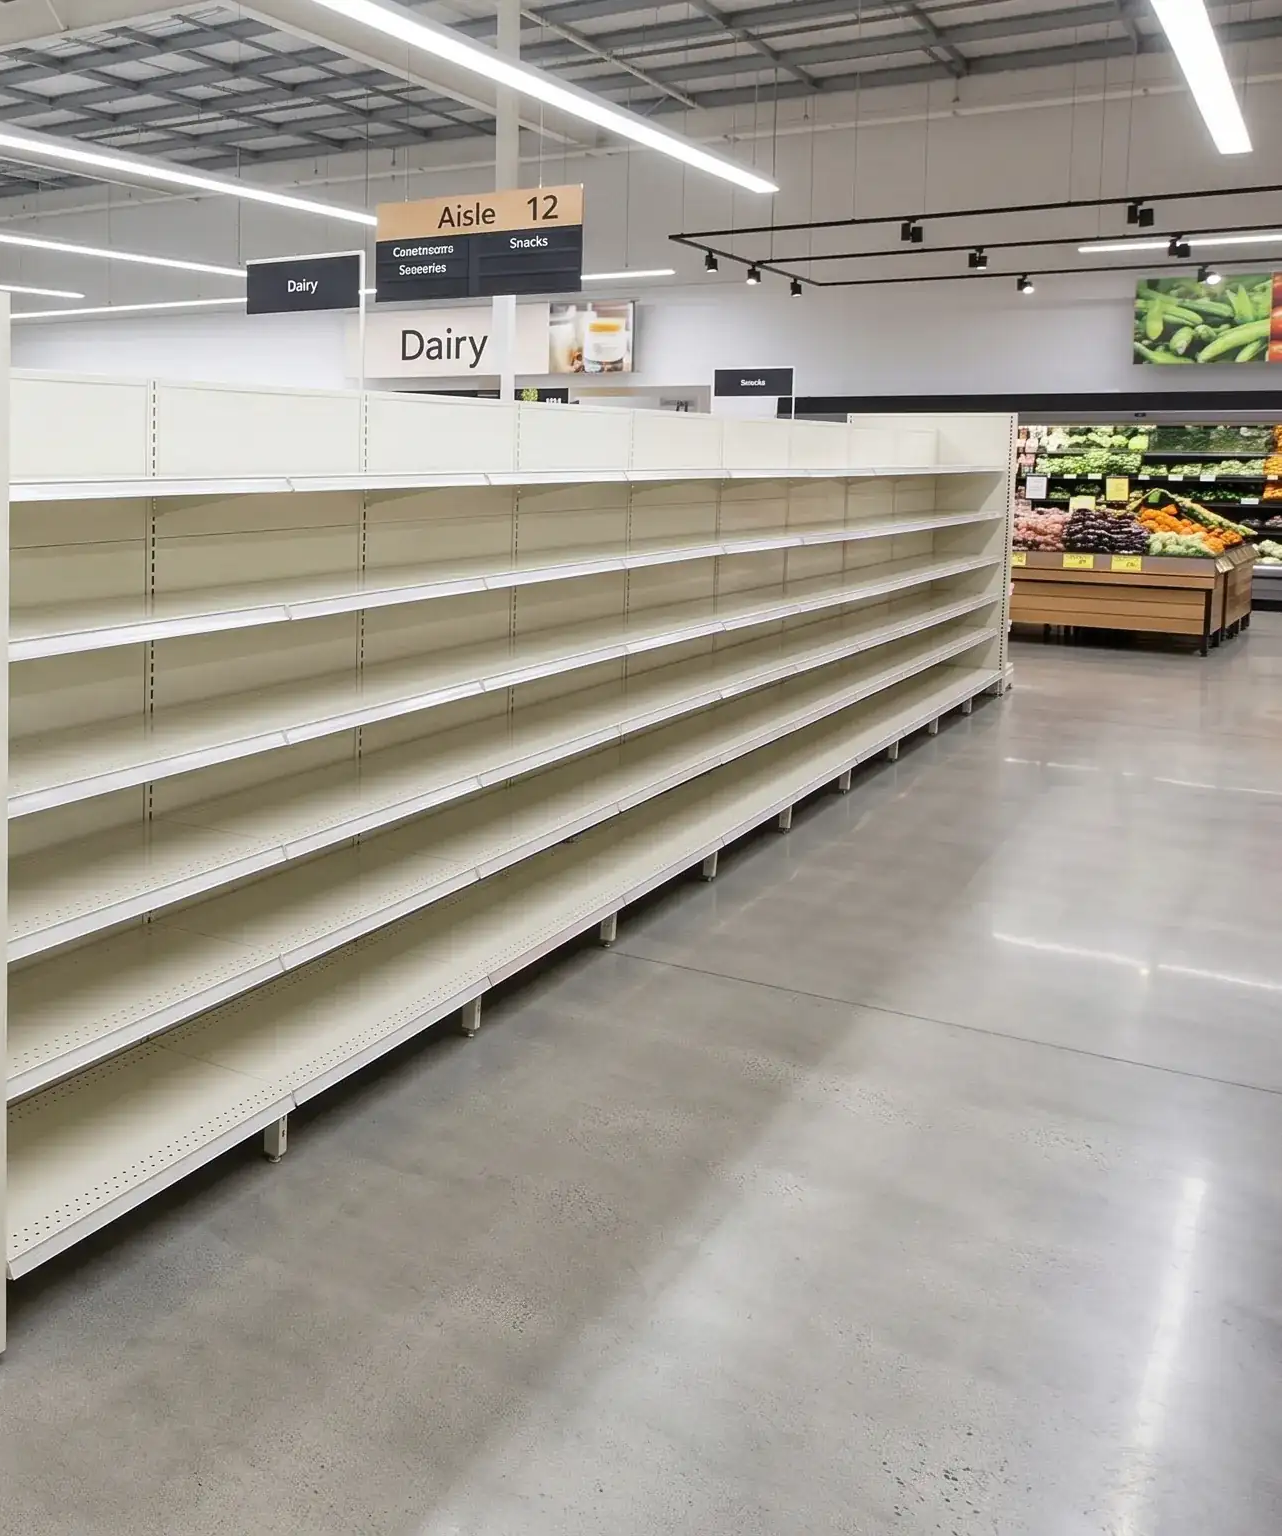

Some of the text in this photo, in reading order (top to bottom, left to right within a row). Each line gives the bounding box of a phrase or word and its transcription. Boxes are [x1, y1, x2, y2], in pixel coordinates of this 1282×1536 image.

[437, 194, 559, 229] Aisle 12
[509, 235, 549, 249] Snacks
[287, 279, 318, 294] Dairy
[401, 327, 489, 369] Dairy
